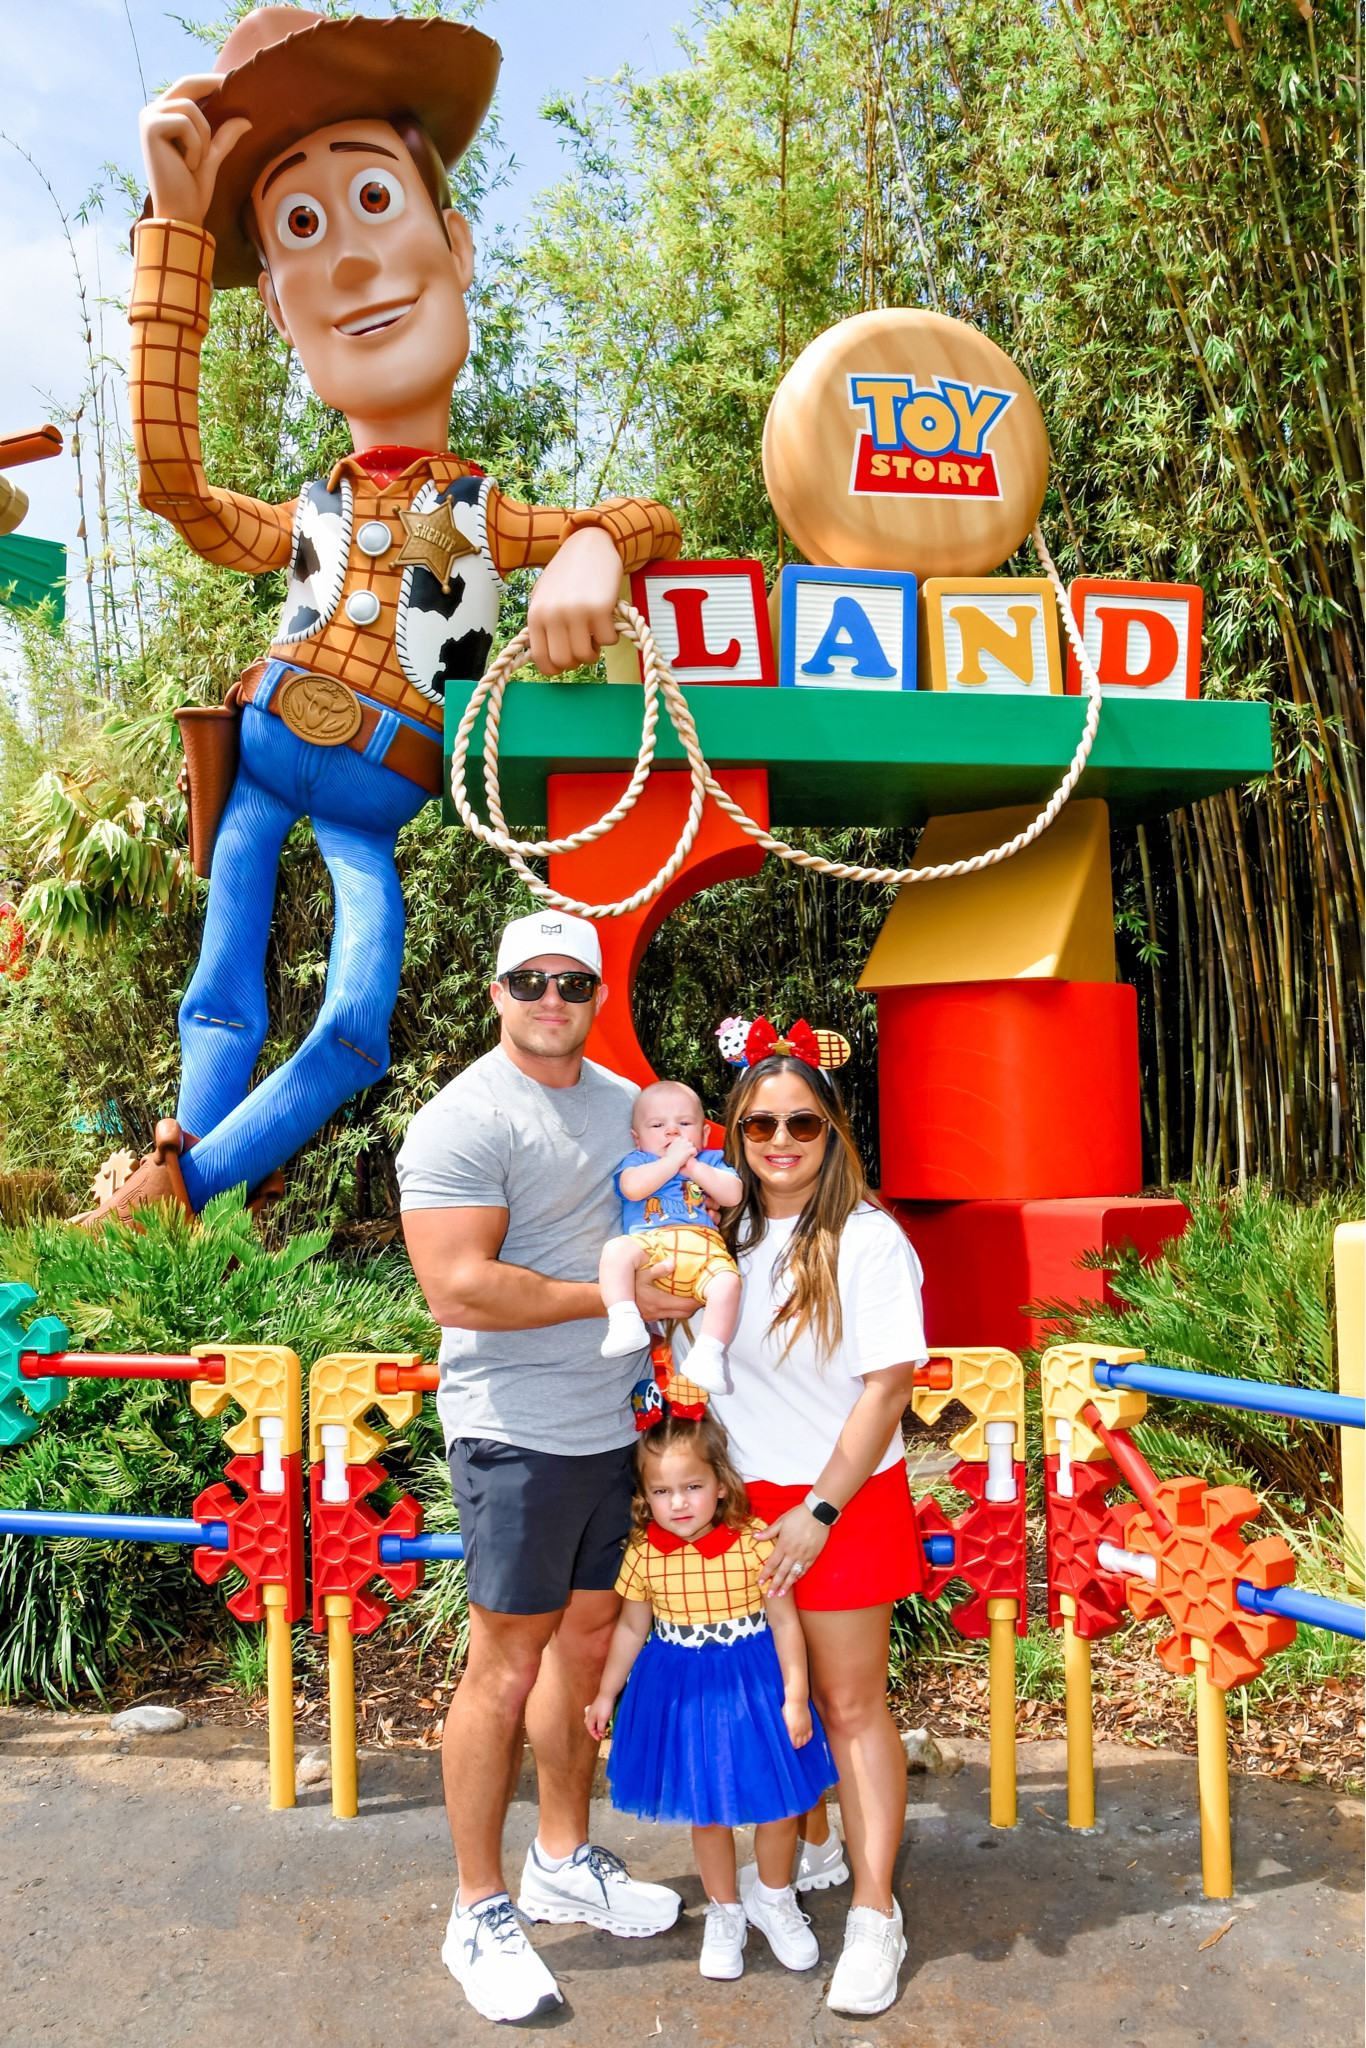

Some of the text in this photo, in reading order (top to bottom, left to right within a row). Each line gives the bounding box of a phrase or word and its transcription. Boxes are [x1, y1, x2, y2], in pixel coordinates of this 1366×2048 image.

[852, 379, 1010, 457] TOY
[870, 454, 985, 487] STORY
[414, 523, 456, 552] SHERIFF
[662, 588, 1180, 688] LAND
